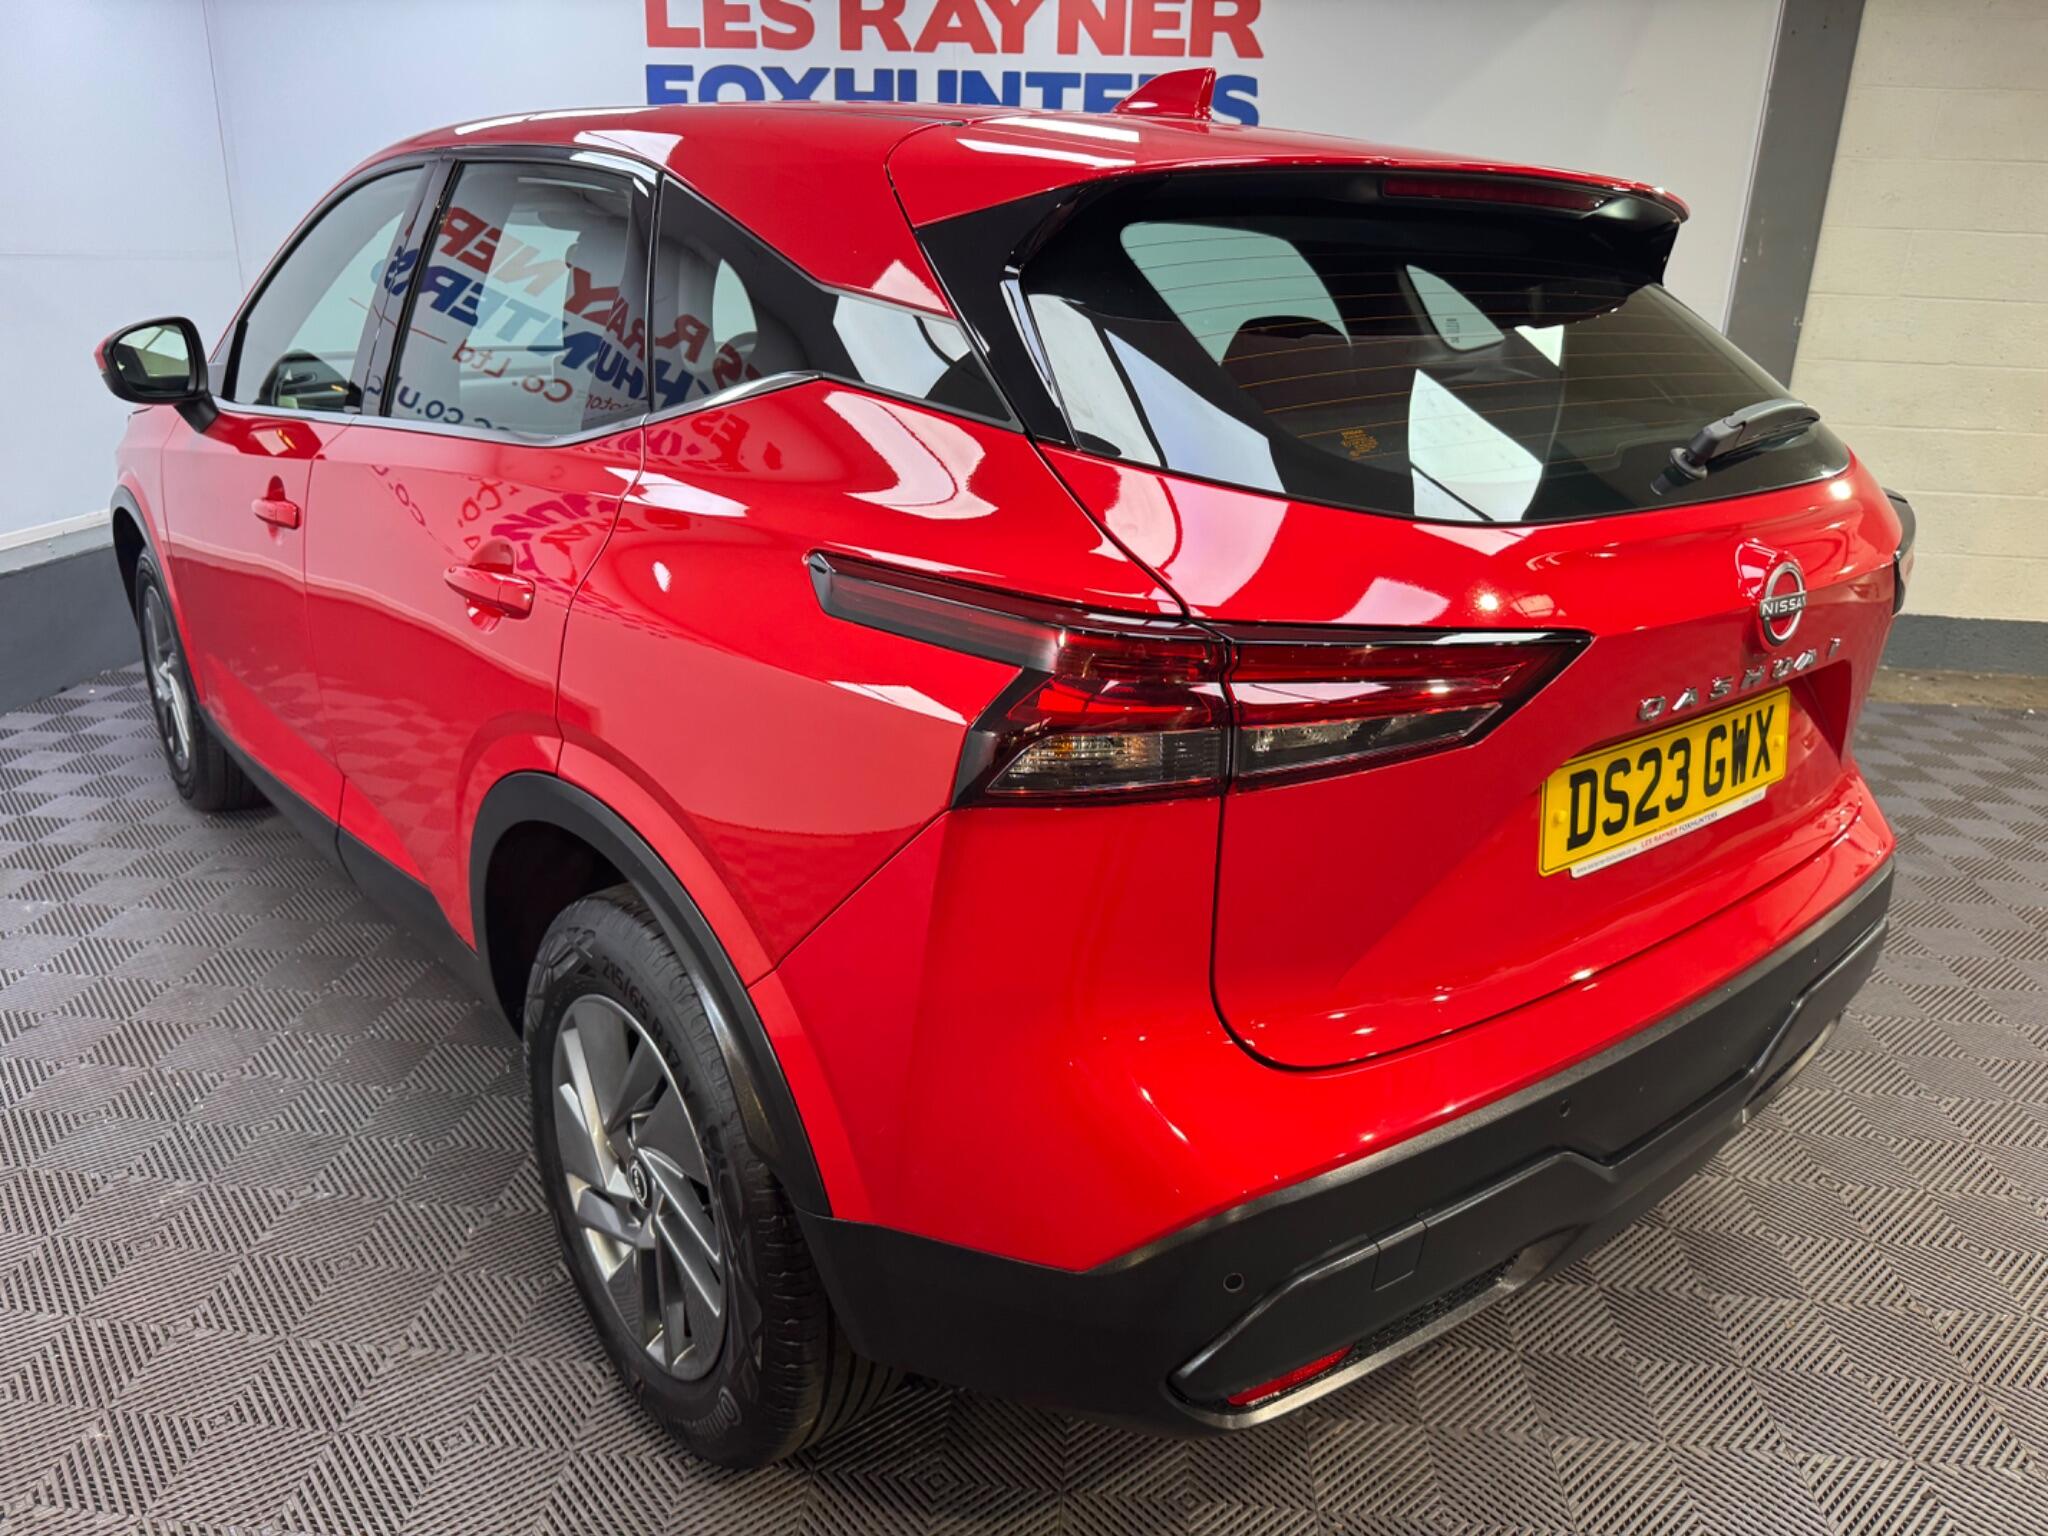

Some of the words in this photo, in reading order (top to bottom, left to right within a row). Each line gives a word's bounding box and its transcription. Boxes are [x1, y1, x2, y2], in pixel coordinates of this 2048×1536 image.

[645, 0, 816, 51] LES
[839, 0, 1265, 59] RAYNER
[645, 64, 1260, 127] FOXHUNTES
[1566, 736, 1692, 851] DS23
[1703, 704, 1775, 798] GWX
[1679, 811, 1719, 831] FOXHUNTERS
